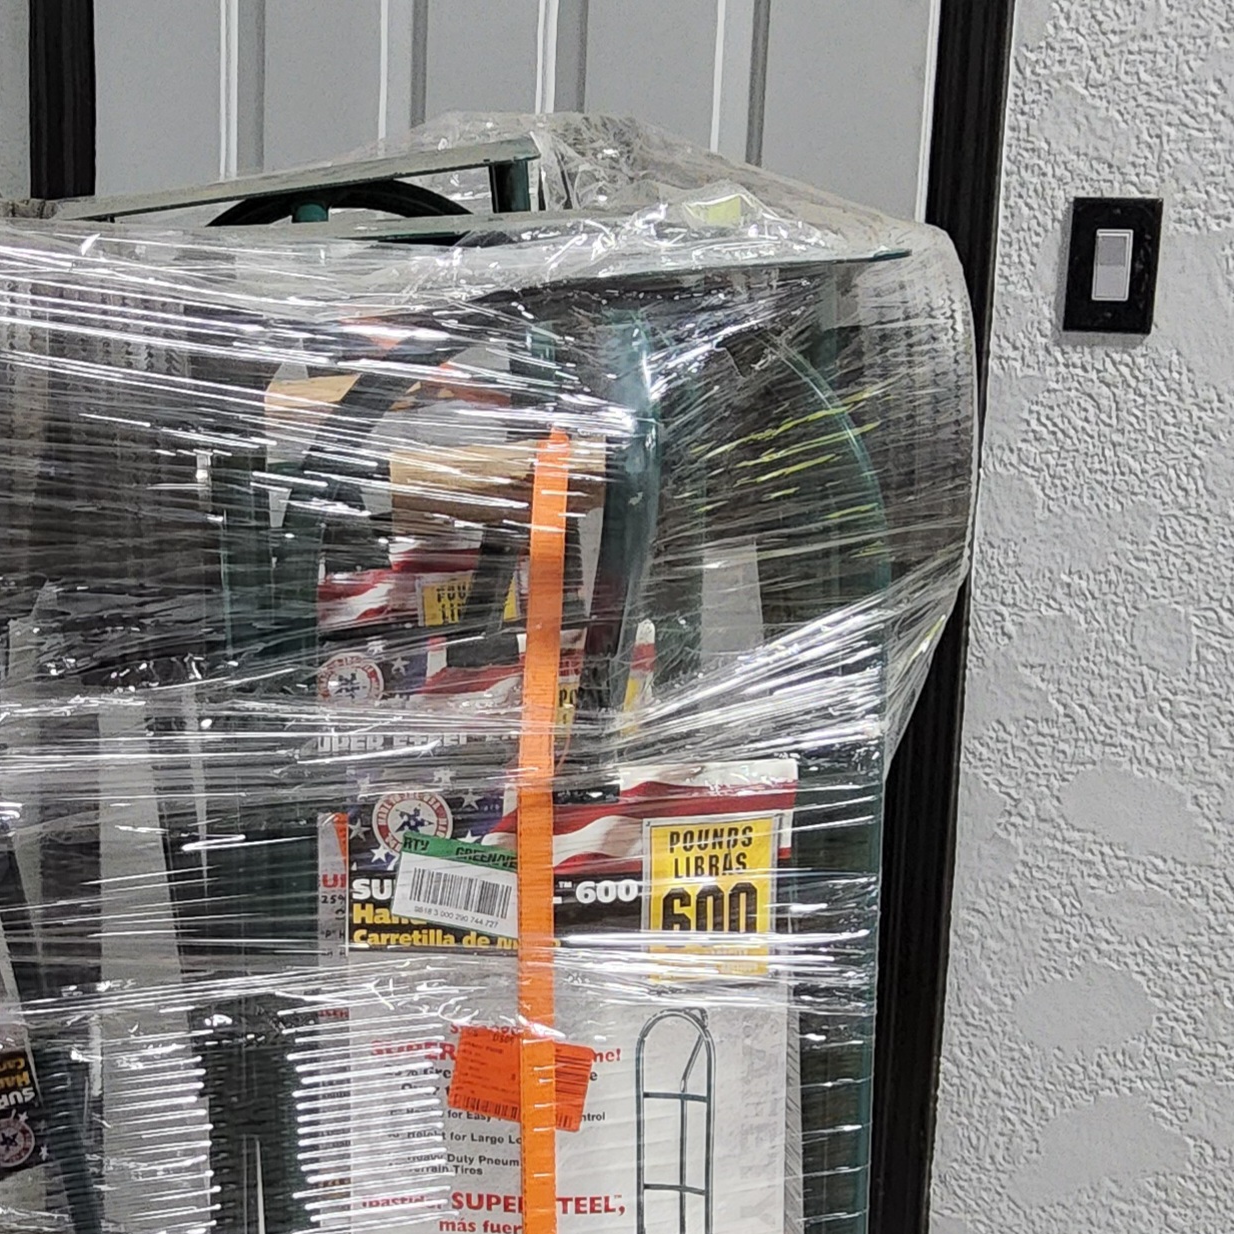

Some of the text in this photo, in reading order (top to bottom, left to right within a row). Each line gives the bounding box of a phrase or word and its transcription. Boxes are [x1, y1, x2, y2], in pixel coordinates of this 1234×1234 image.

[669, 825, 754, 853] POUNDS
[674, 852, 748, 879] LIBRAS
[575, 878, 639, 905] 600
[353, 929, 456, 949] Carretilla
[463, 931, 491, 949] de
[450, 1133, 466, 1142] for
[470, 1133, 505, 1146] Large
[447, 1153, 475, 1168] Duty
[452, 1165, 483, 1176] Tires
[439, 1218, 477, 1233] más
